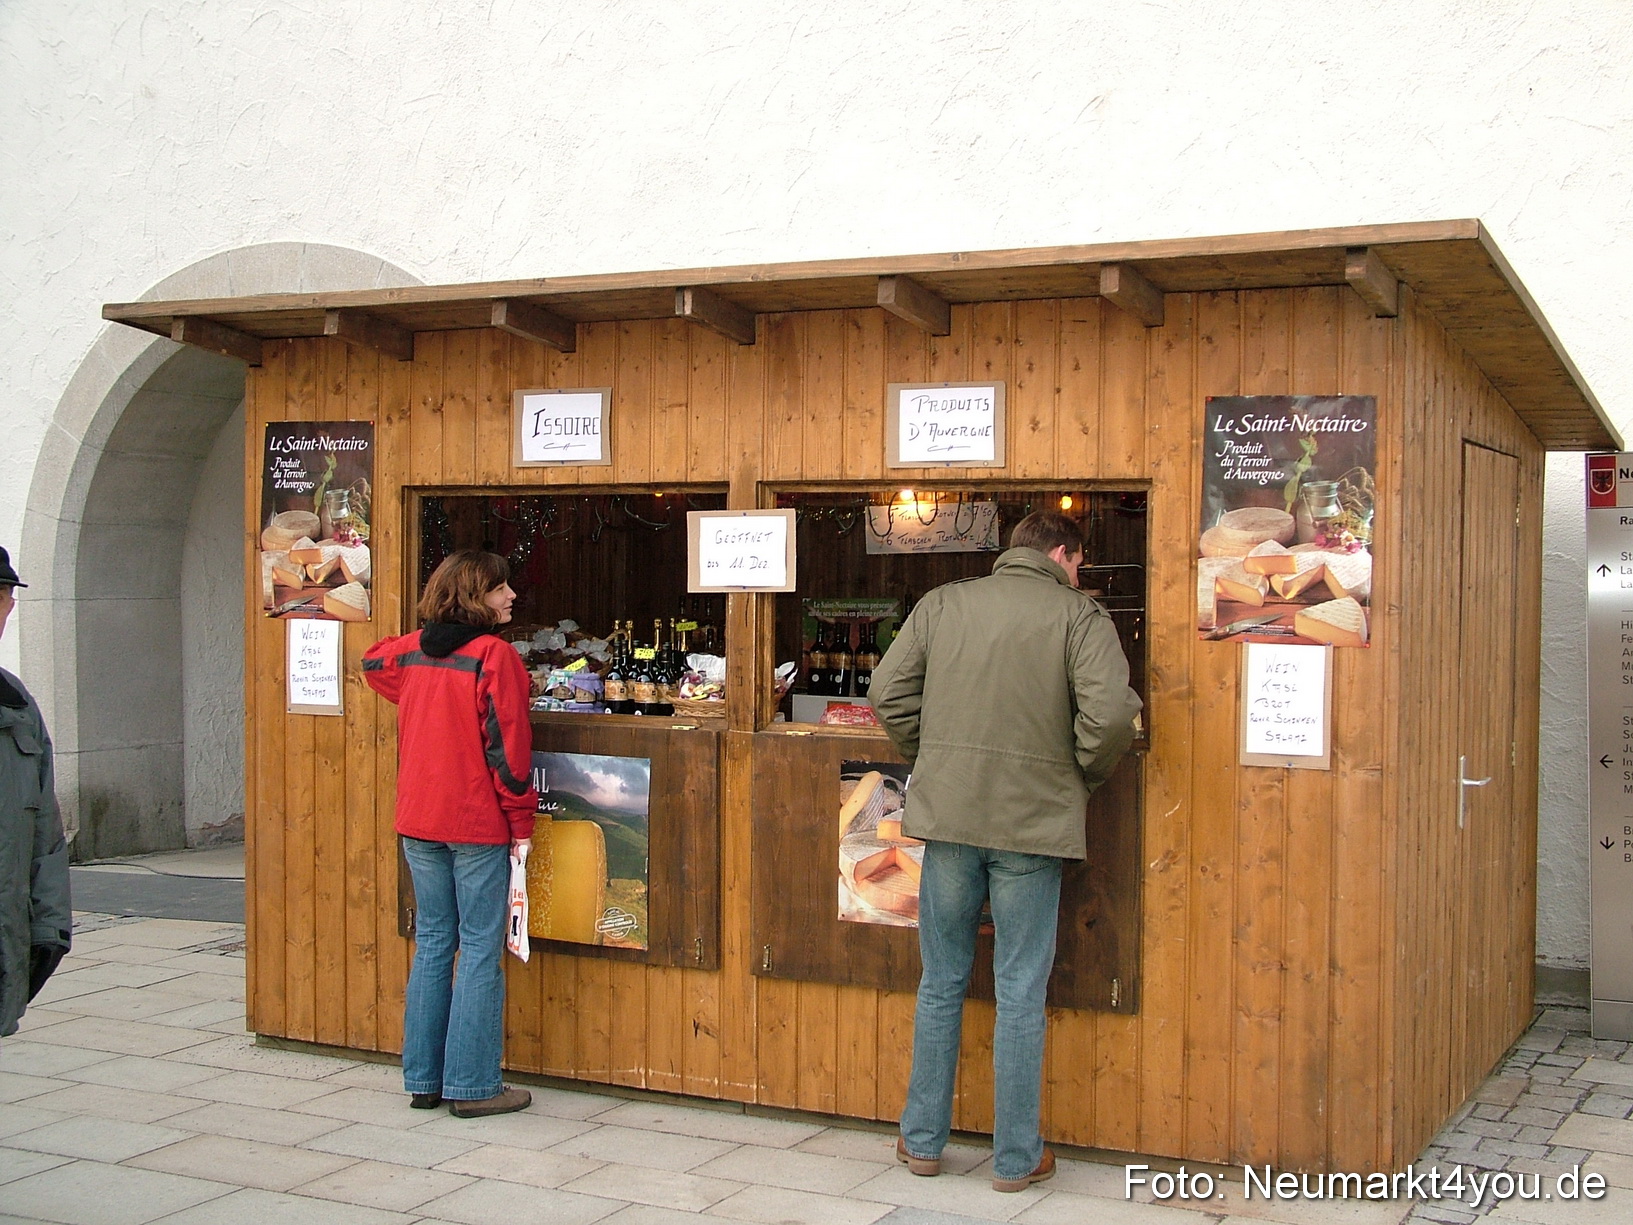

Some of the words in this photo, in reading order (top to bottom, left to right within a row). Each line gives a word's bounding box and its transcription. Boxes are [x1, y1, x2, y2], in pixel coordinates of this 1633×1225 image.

[910, 394, 990, 413] PRODUITS
[531, 408, 600, 438] ISSOIRE
[908, 421, 993, 442] D'AUVERGNE
[1213, 414, 1234, 433] Le
[1234, 412, 1368, 435] Saint-Nectaire
[269, 436, 283, 451] Le
[282, 435, 369, 453] Saint-Nectaire
[1215, 440, 1264, 457] Produit
[270, 456, 301, 470] Produit
[1220, 455, 1235, 467] du
[1237, 455, 1272, 467] Terroir
[272, 468, 282, 478] du
[283, 468, 307, 478] Terroir
[1223, 468, 1285, 485] d'Auvergne
[274, 479, 315, 493] d'Auvergne
[715, 528, 773, 545] GEÖFFNET
[301, 623, 326, 640] WEIN
[298, 660, 323, 670] BROT
[1265, 653, 1300, 674] WEIN
[1253, 697, 1291, 709] BROT
[530, 767, 550, 793] AL
